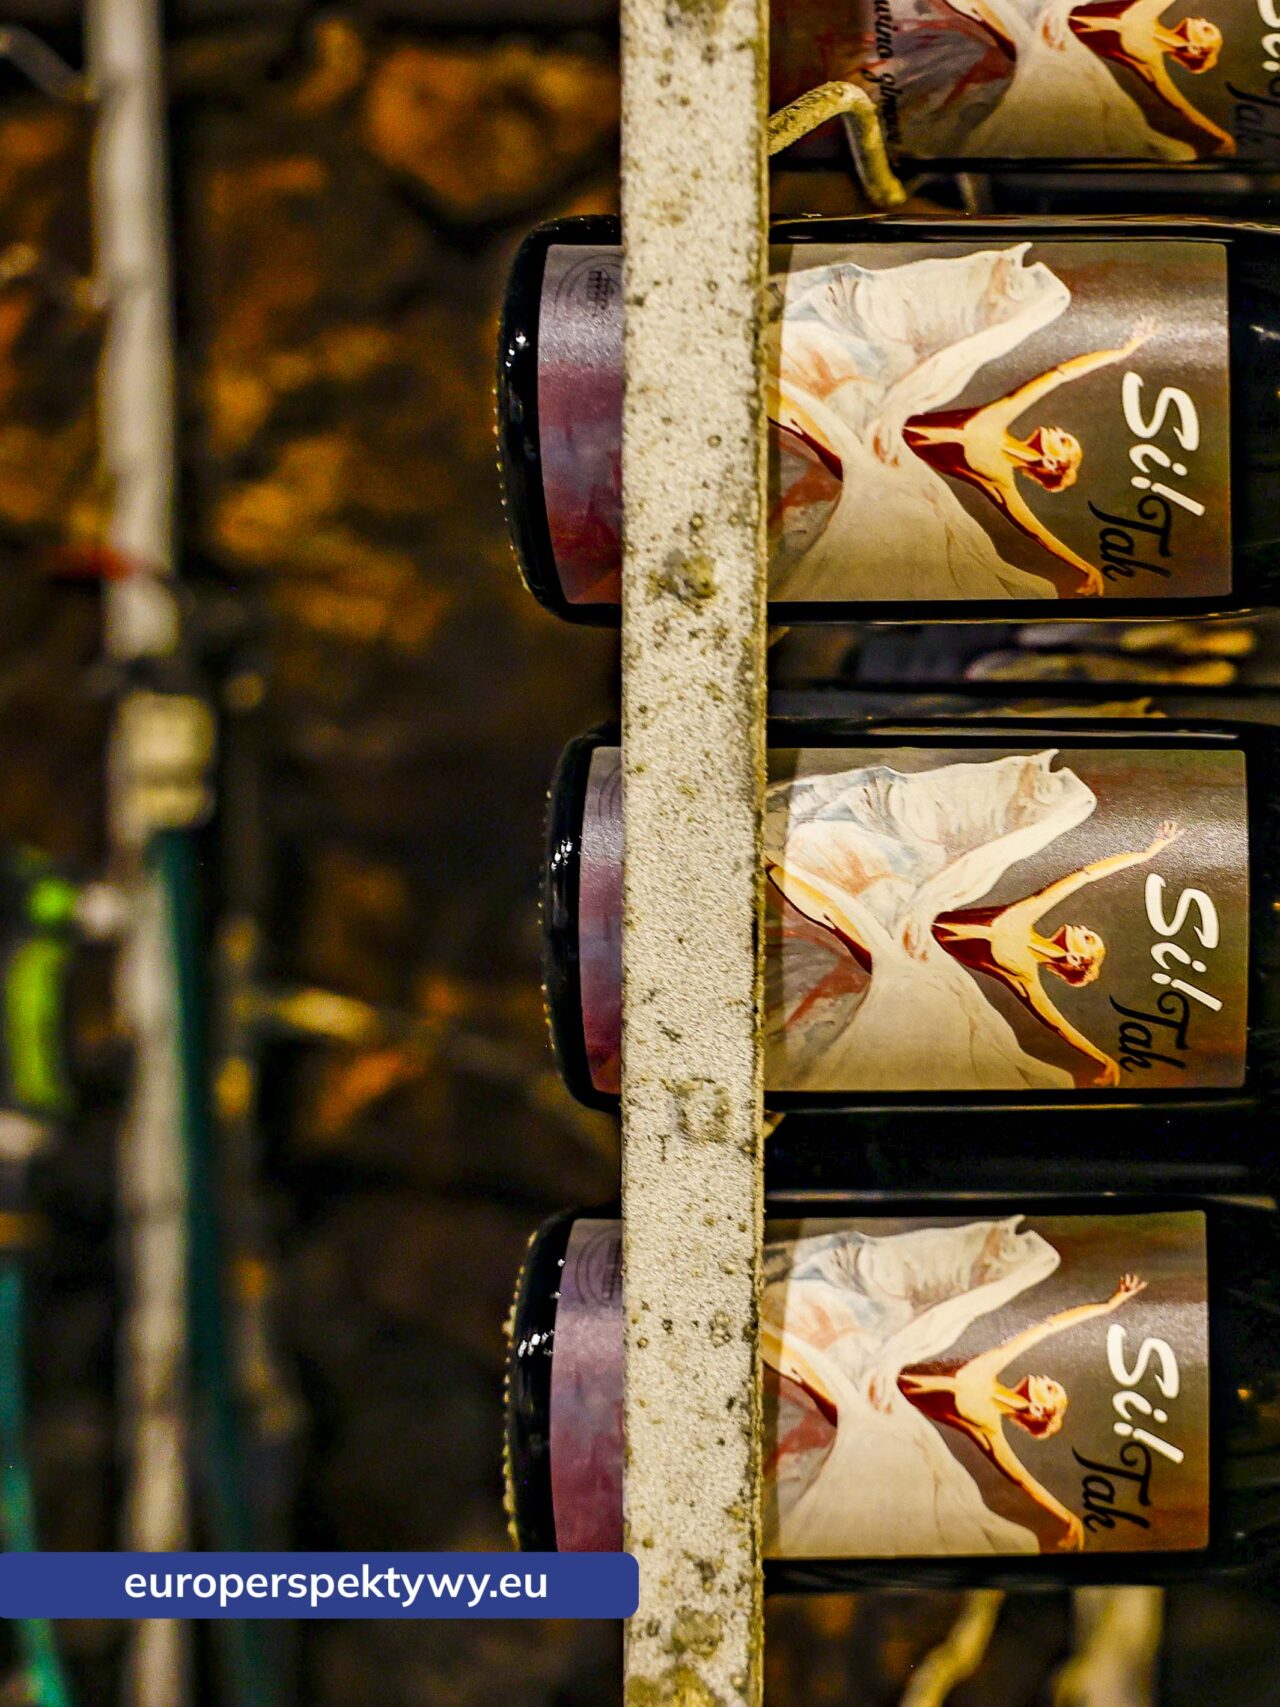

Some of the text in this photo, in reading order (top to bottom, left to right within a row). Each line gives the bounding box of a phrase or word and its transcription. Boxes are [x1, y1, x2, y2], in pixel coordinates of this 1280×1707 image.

[1087, 371, 1206, 583] Si! Tak
[1109, 872, 1224, 1073] Si! Tak
[1071, 1322, 1185, 1532] Si! Tak
